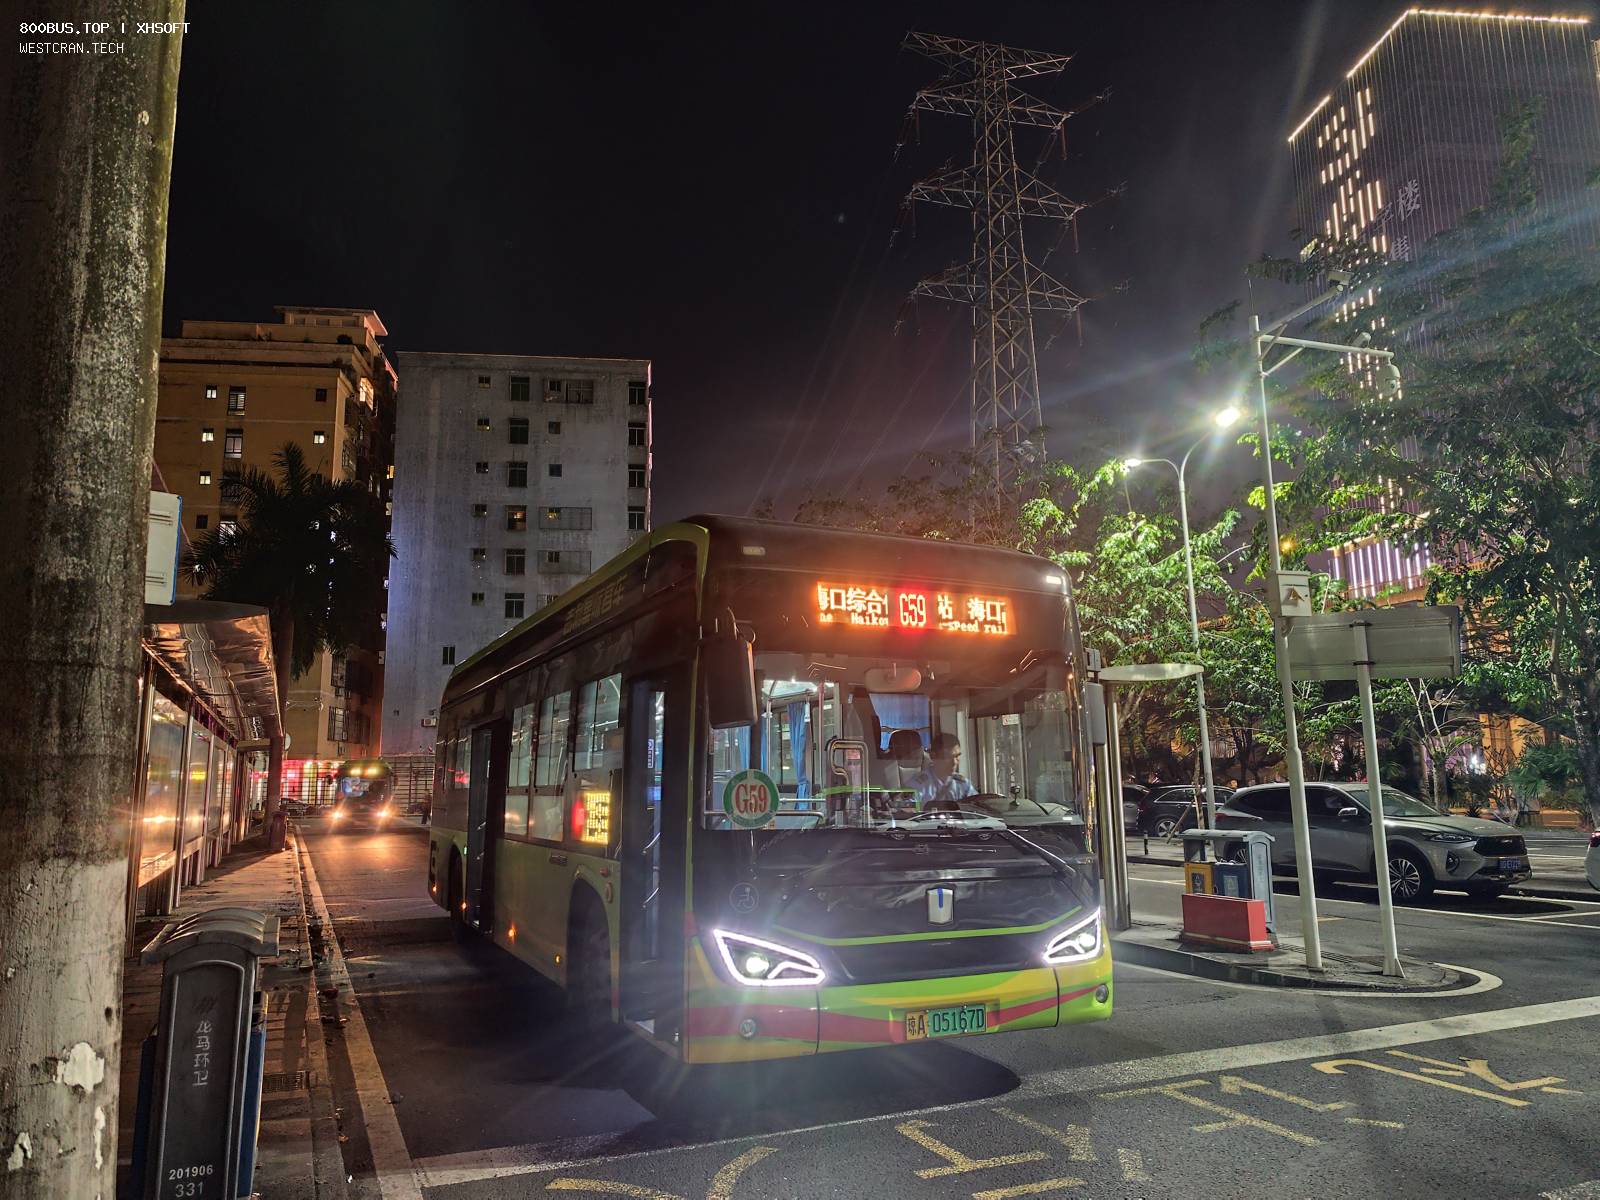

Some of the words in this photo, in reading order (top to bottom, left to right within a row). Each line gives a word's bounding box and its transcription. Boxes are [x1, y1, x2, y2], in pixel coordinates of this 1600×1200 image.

[899, 593, 927, 626] G59
[937, 594, 953, 619] 站
[735, 783, 768, 814] G59
[933, 1008, 985, 1034] 05167D
[169, 1165, 214, 1181] 201906
[175, 1181, 204, 1198] 331
